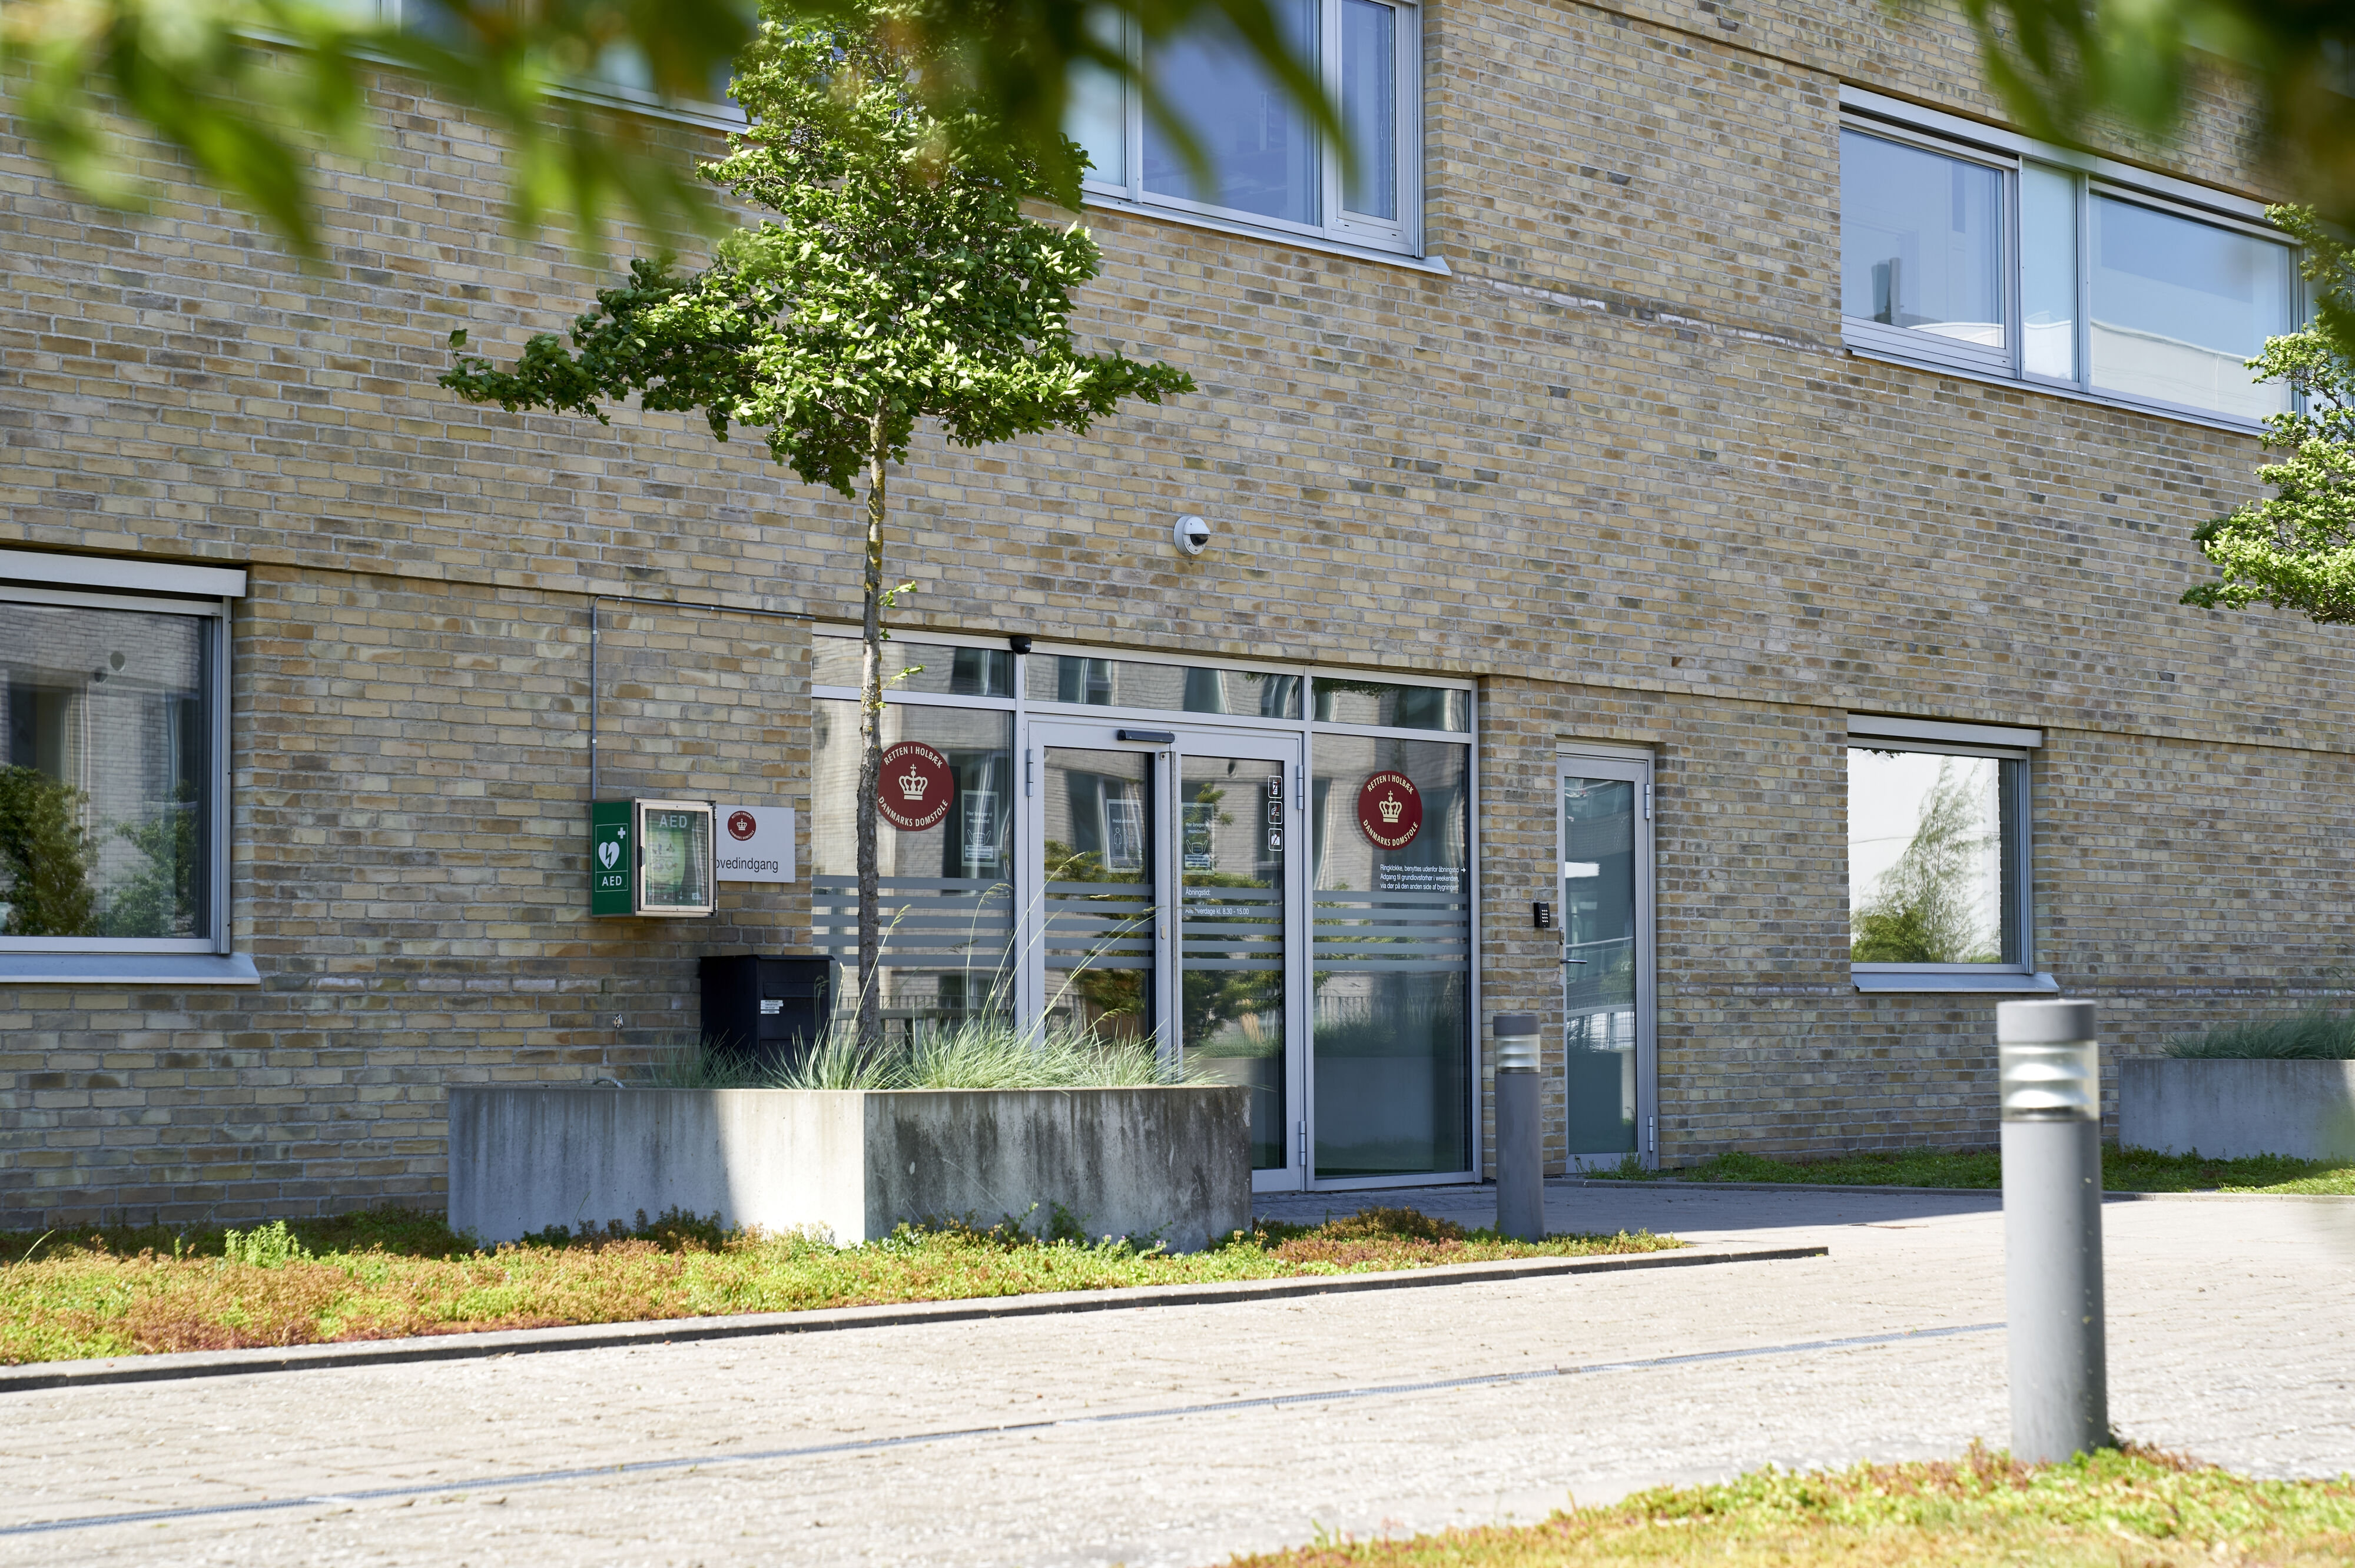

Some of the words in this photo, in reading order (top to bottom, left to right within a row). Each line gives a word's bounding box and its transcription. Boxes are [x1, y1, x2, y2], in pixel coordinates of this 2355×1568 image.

[884, 746, 908, 765] RETTEN
[910, 746, 913, 754] I
[915, 746, 943, 769] HOLBÆK
[1367, 775, 1387, 792] RETTEN
[1392, 775, 1414, 795] HOLBÆK
[878, 796, 913, 827] DANMARKS
[915, 799, 948, 827] DOMSTOLE
[659, 814, 688, 828] AED
[1364, 819, 1390, 846] DANMARKS
[1392, 822, 1418, 846] DOMSTOLE
[717, 857, 778, 873] ovedindgang
[1380, 864, 1404, 872] Ringklokke,
[1438, 866, 1459, 874] åbningstid
[602, 876, 622, 886] AED
[1185, 886, 1210, 897] Åbningstid:
[1195, 907, 1215, 916] hverdage
